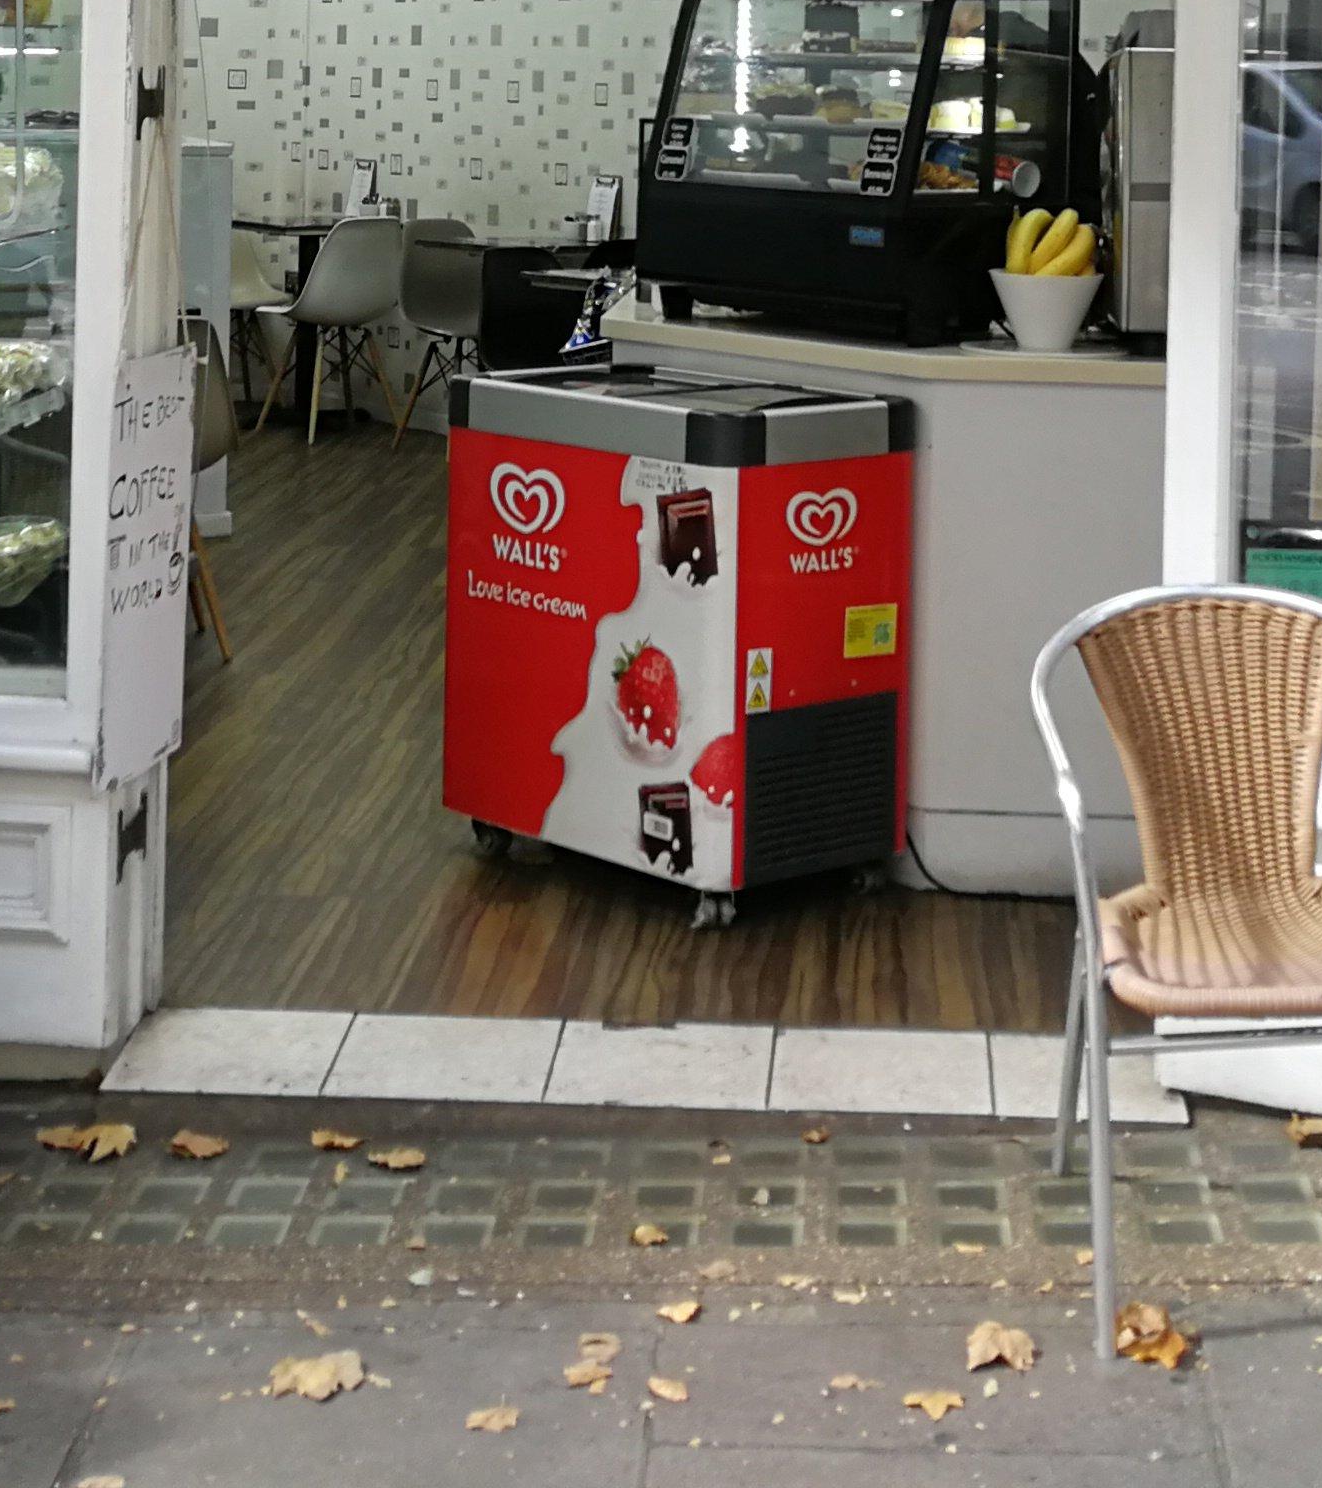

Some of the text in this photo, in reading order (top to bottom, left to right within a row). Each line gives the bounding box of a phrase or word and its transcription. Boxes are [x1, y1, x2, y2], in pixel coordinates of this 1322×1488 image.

[114, 396, 154, 444] THE
[108, 464, 177, 521] COFFEE
[492, 533, 561, 573] WALL'S
[789, 546, 854, 574] WALL'S
[110, 578, 163, 615] WORLD
[467, 569, 588, 622] Love ice cream
